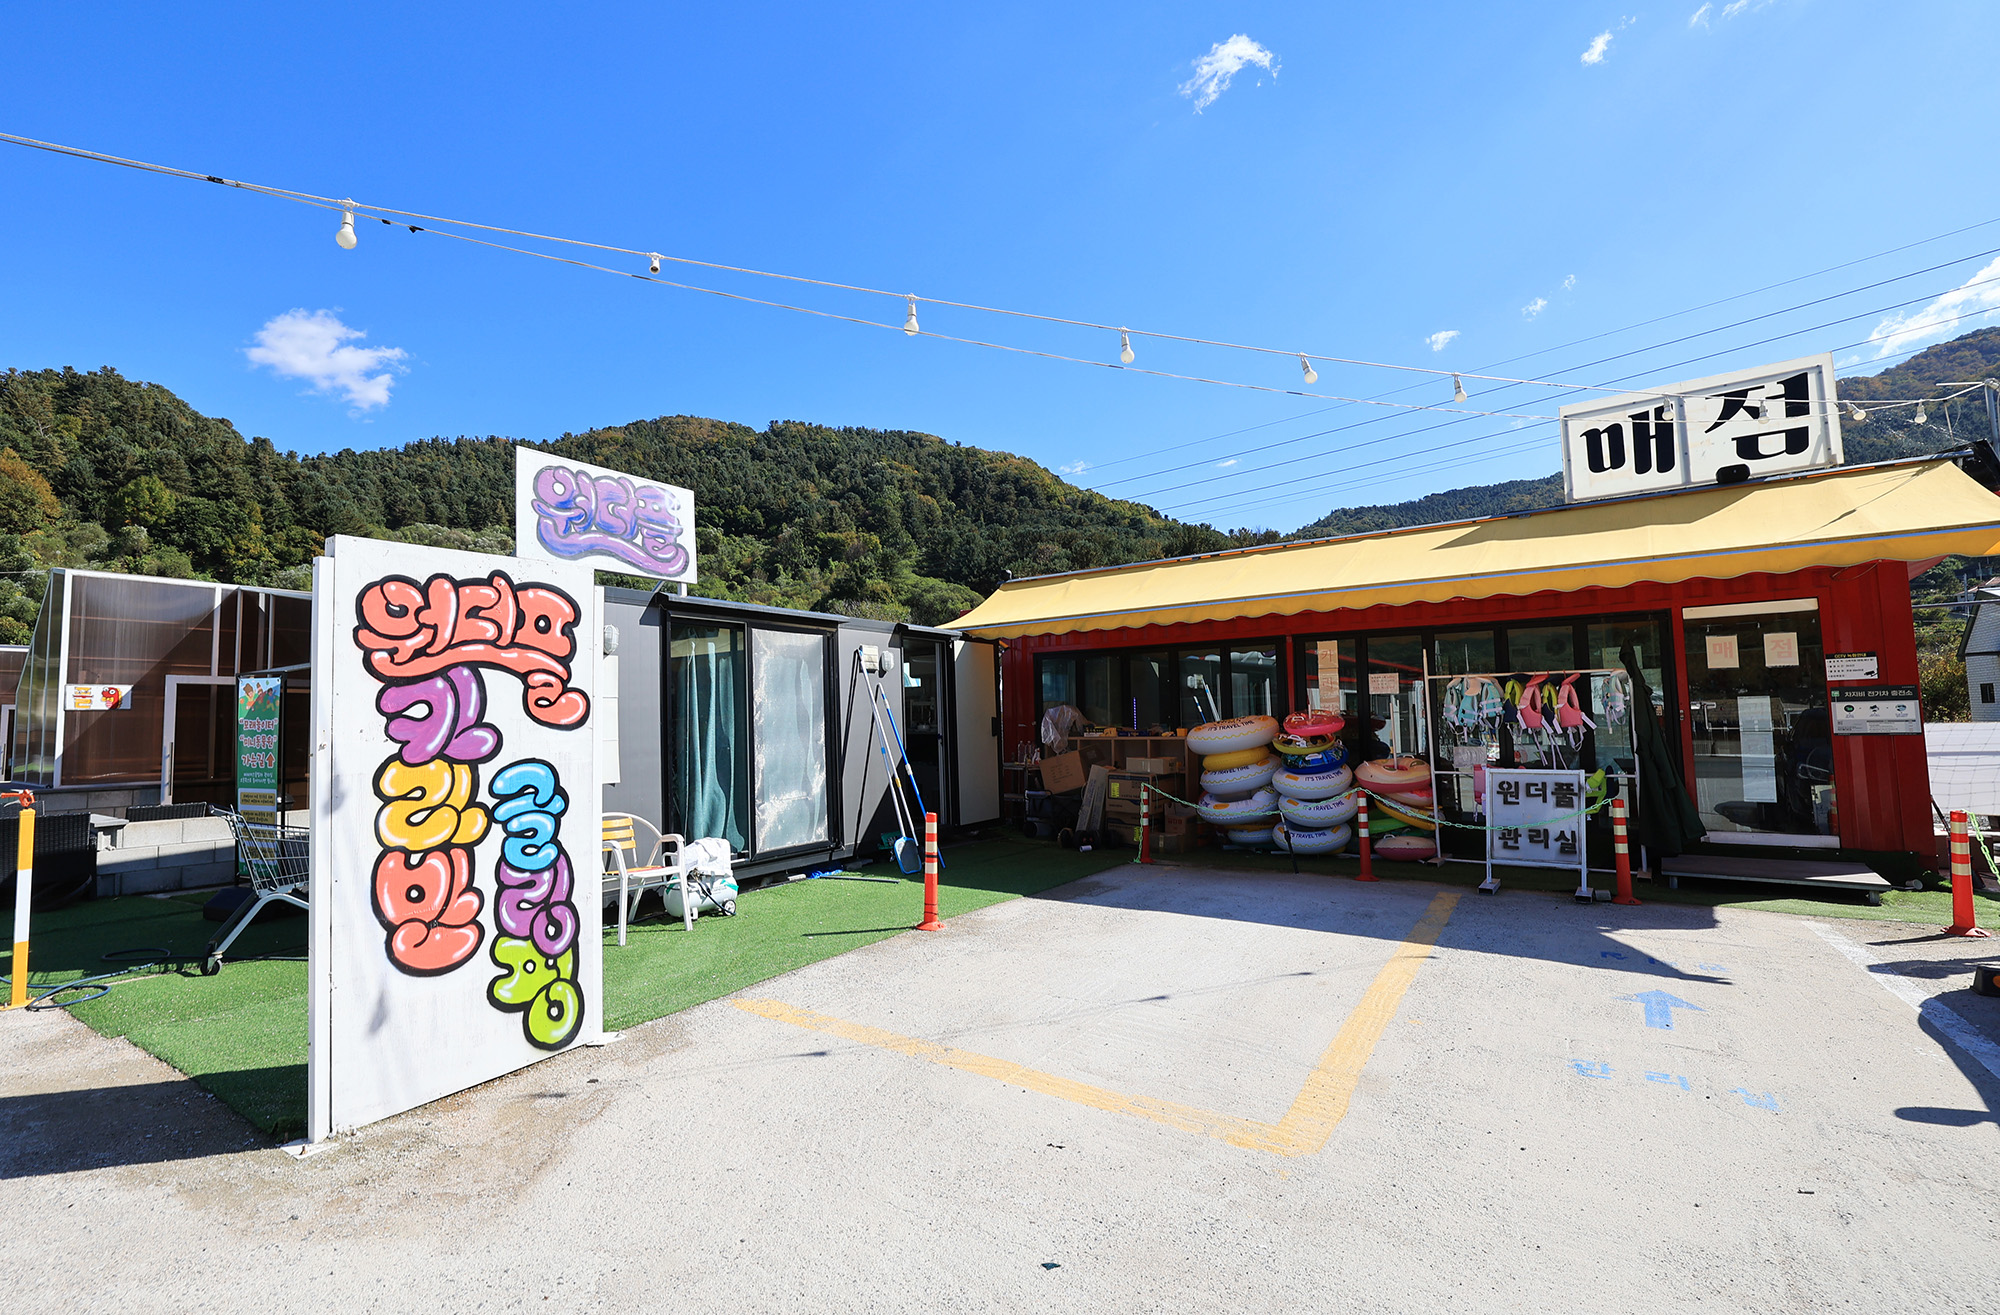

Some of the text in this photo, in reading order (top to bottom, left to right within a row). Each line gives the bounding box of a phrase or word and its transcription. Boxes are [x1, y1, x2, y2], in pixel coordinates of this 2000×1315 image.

[1580, 372, 1809, 474] 매점
[353, 570, 590, 730] 원더풀
[1890, 689, 1913, 697] 충전소
[1218, 722, 1242, 731] TRAVEL
[1315, 773, 1334, 781] TRAVEL
[1332, 800, 1344, 808] TIME
[1496, 781, 1579, 808] 원더풀
[371, 665, 502, 977] 카라반
[1497, 827, 1577, 854] 관리실
